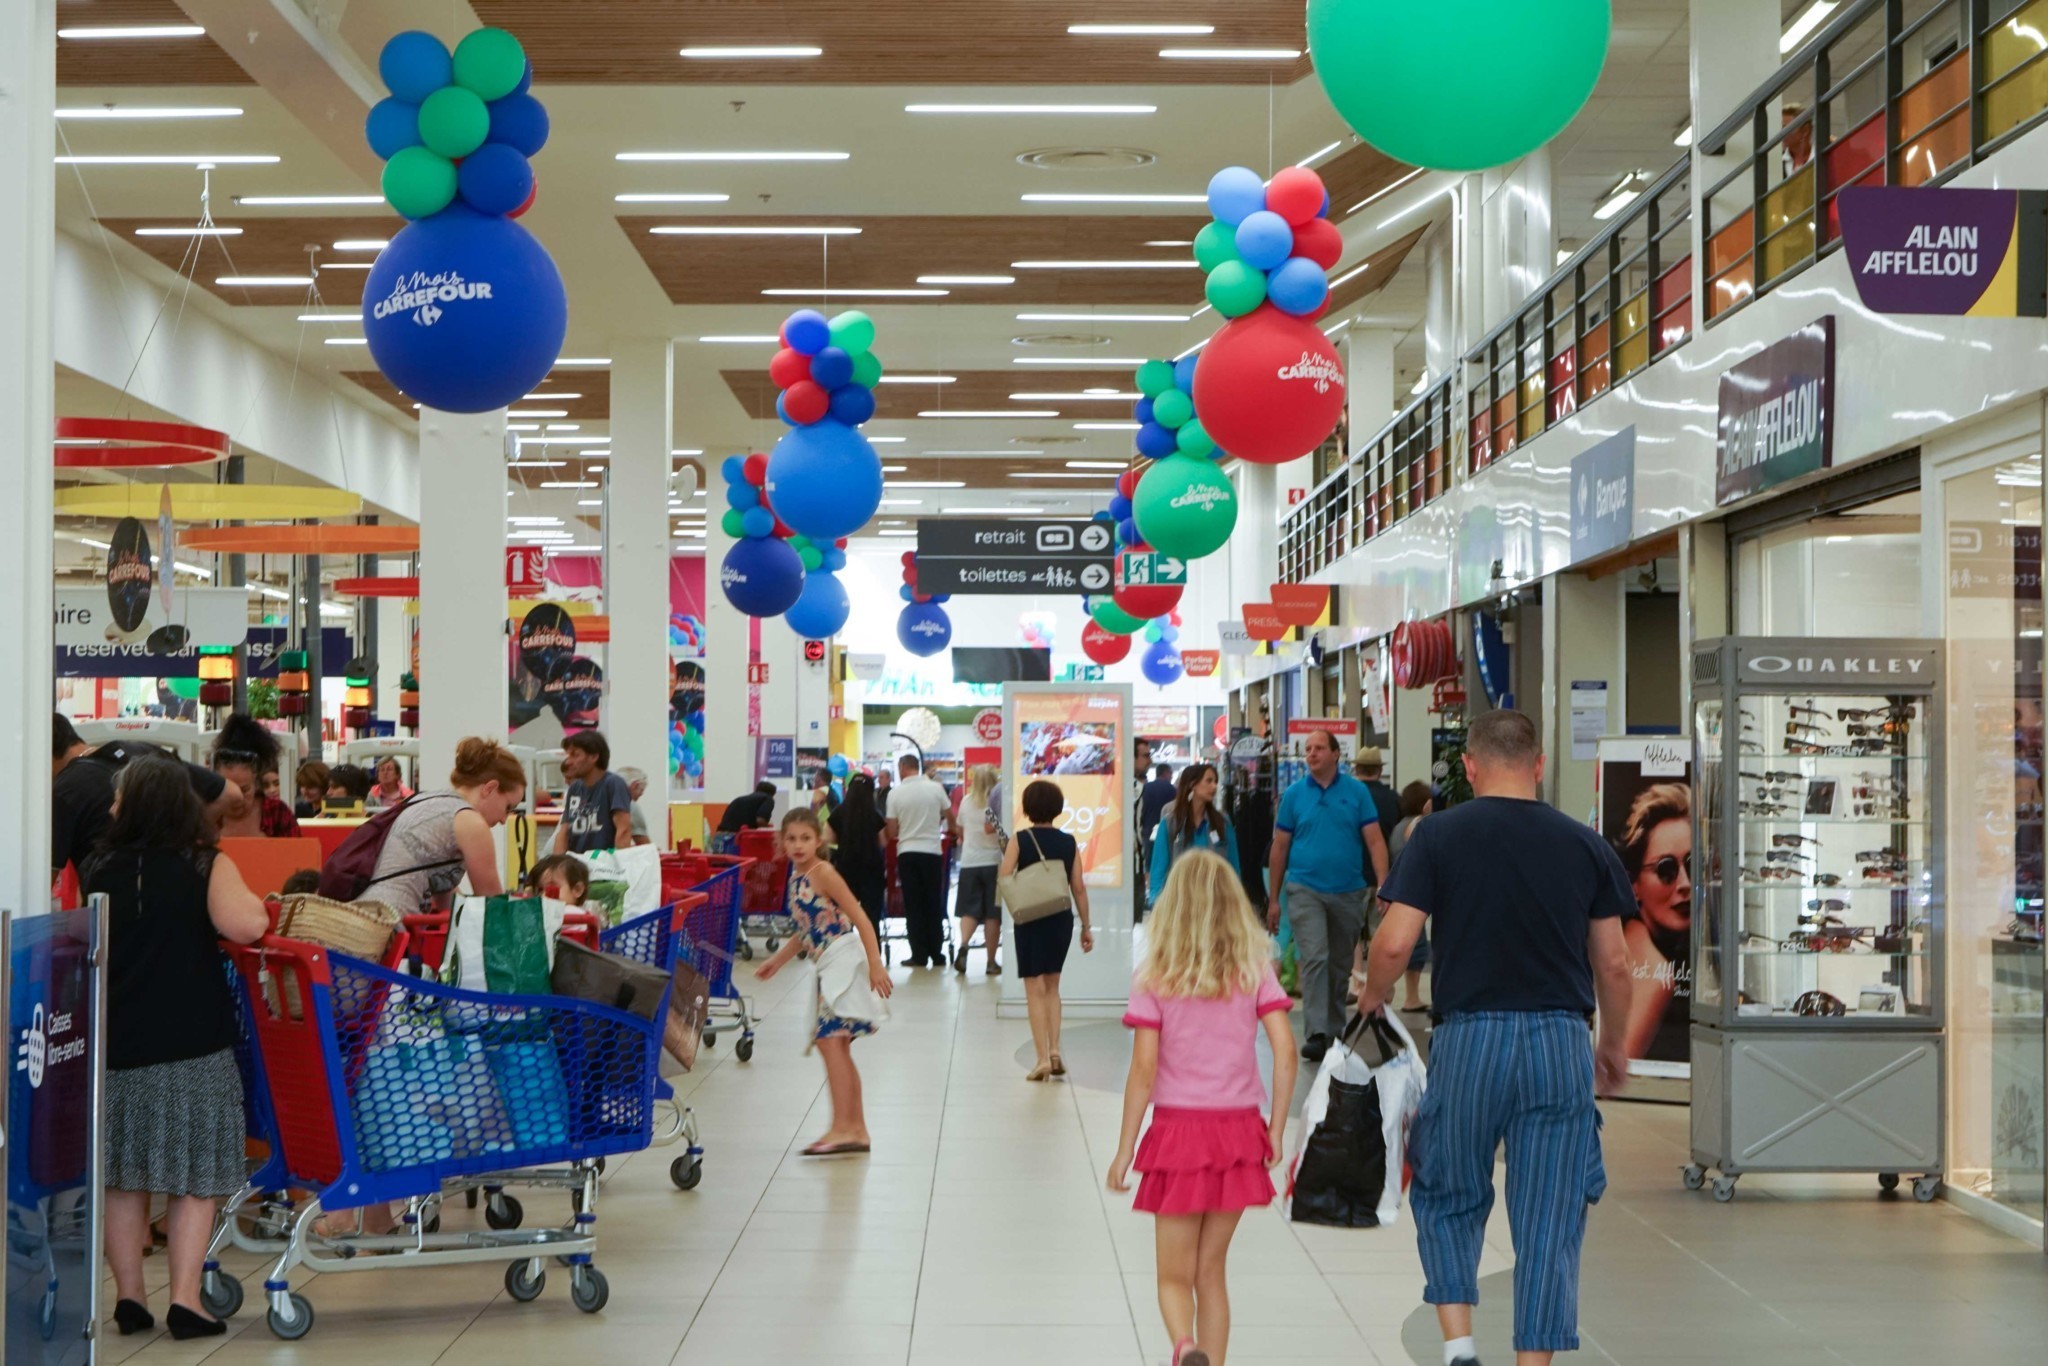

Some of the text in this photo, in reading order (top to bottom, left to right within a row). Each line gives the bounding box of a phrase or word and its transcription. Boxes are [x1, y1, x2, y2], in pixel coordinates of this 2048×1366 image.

[1904, 225, 1978, 249] ALAIN
[1862, 251, 1978, 276] AFFLELOU
[373, 282, 493, 320] CARREFOUR
[1752, 379, 1818, 465] AFFLELOU
[1596, 475, 1627, 523] Banque
[975, 529, 1026, 545] retrait
[109, 563, 150, 584] CARREFOUR
[959, 566, 1027, 584] toilettes
[522, 634, 574, 649] CARREFOUR
[1797, 657, 1923, 673] OAKLEY
[48, 1010, 72, 1036] Caisses
[48, 1036, 85, 1067] libre-service
